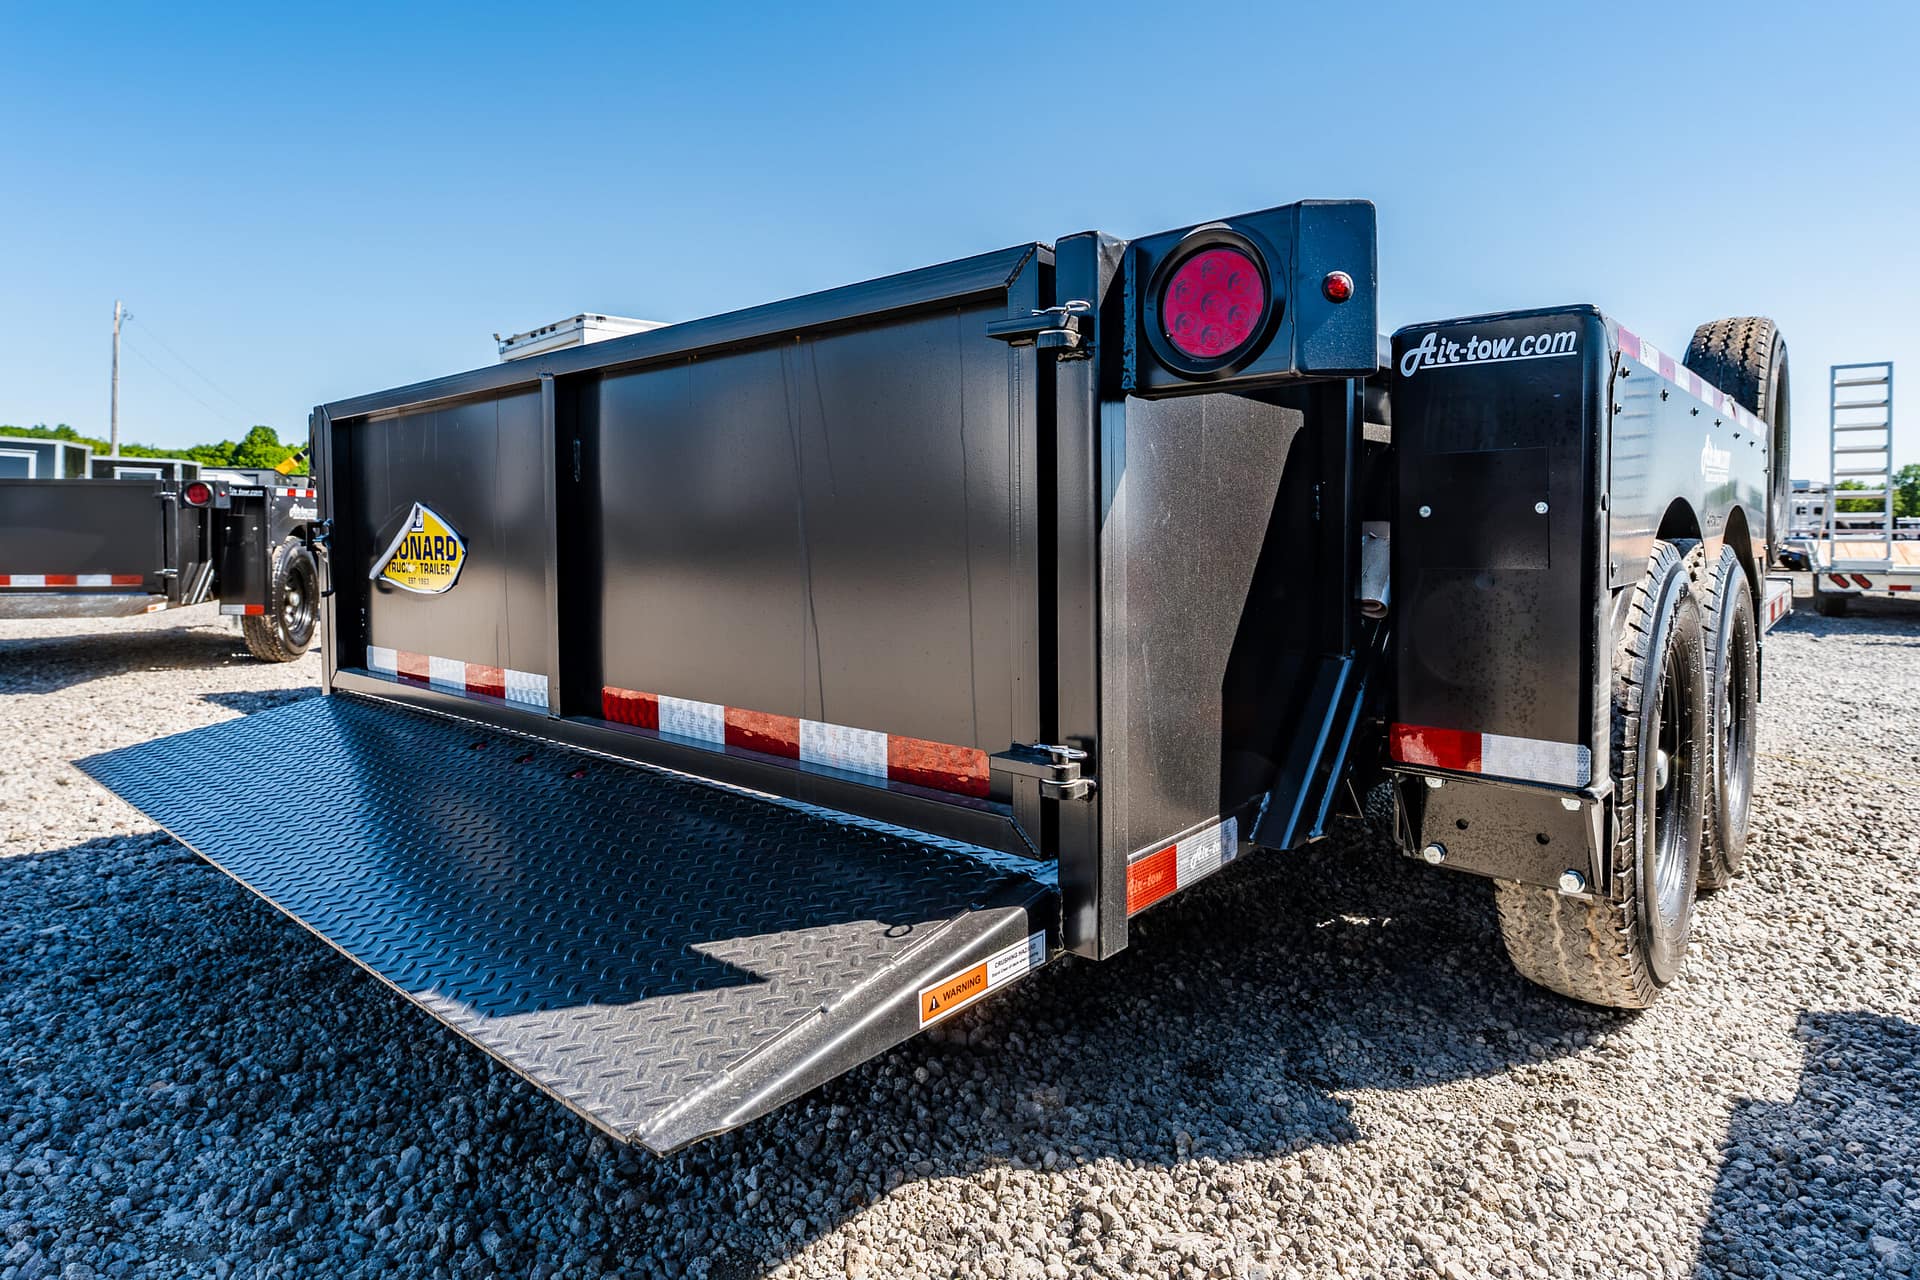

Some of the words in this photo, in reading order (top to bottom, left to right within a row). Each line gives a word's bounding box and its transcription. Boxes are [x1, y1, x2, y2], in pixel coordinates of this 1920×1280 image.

[1400, 331, 1577, 377] Air-tow.com
[420, 562, 450, 575] TRAILER
[943, 975, 981, 1001] WARNING
